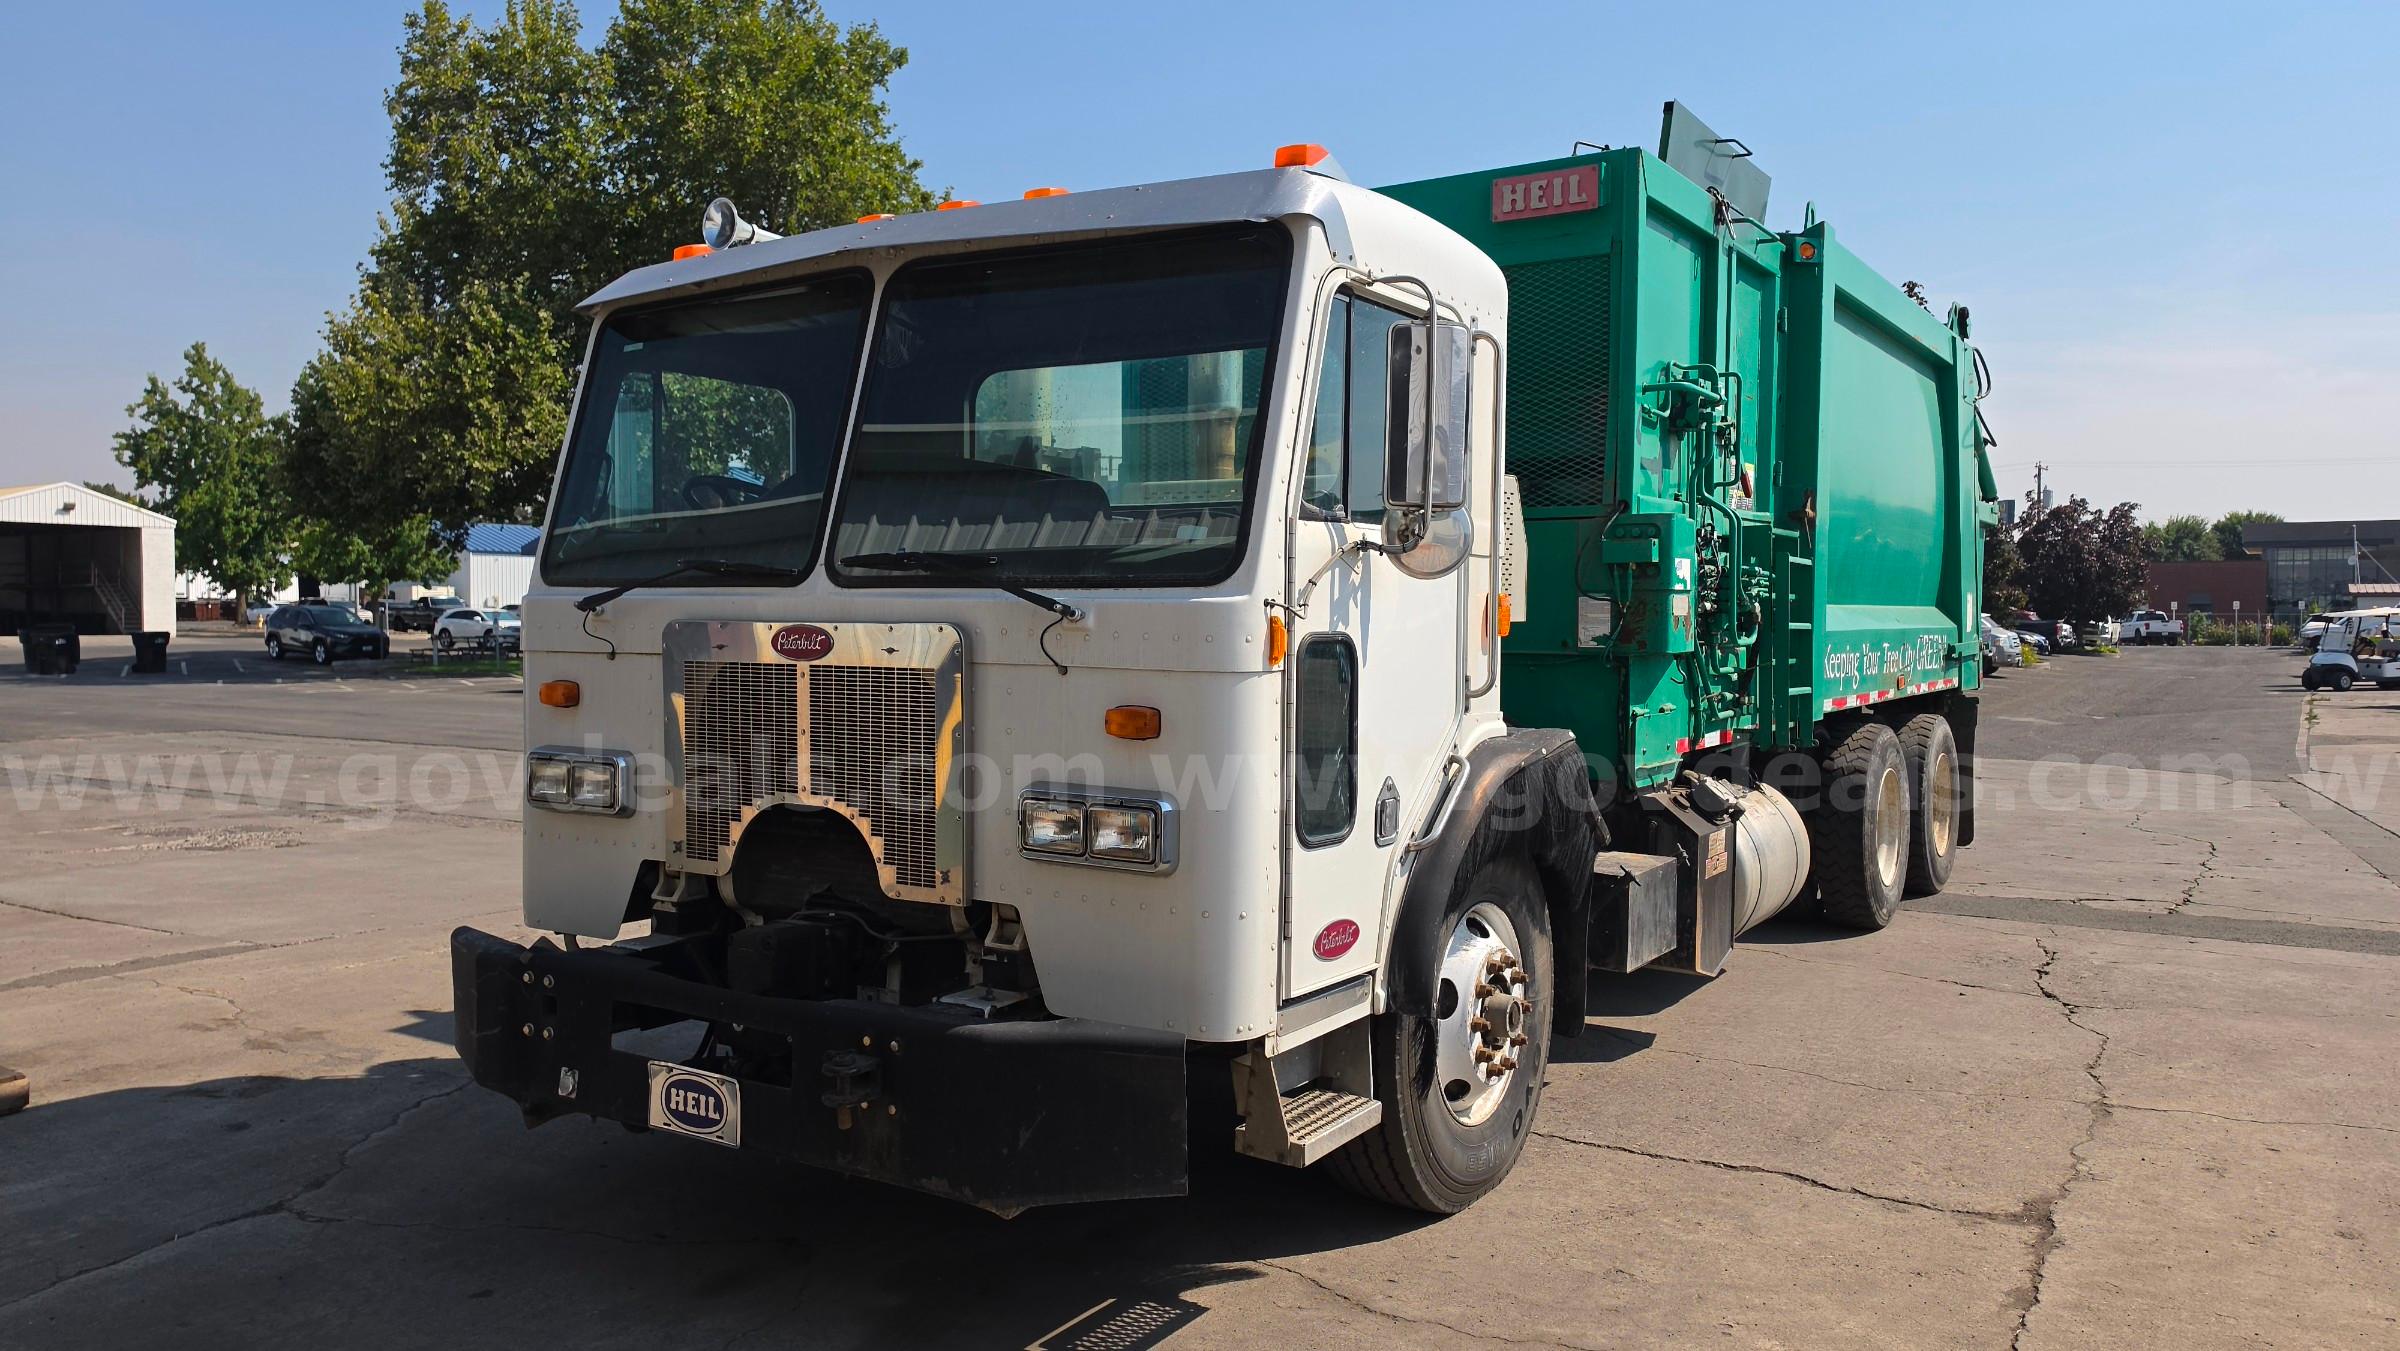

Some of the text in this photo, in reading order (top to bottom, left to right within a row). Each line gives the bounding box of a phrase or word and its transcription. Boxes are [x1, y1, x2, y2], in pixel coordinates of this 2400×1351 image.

[1502, 174, 1588, 213] HEIL
[777, 631, 826, 651] Peterbilt
[1824, 643, 1860, 691] Keeping
[1862, 643, 1880, 675] Your
[1882, 643, 1899, 674] Tree
[669, 1087, 721, 1120] HEIL
